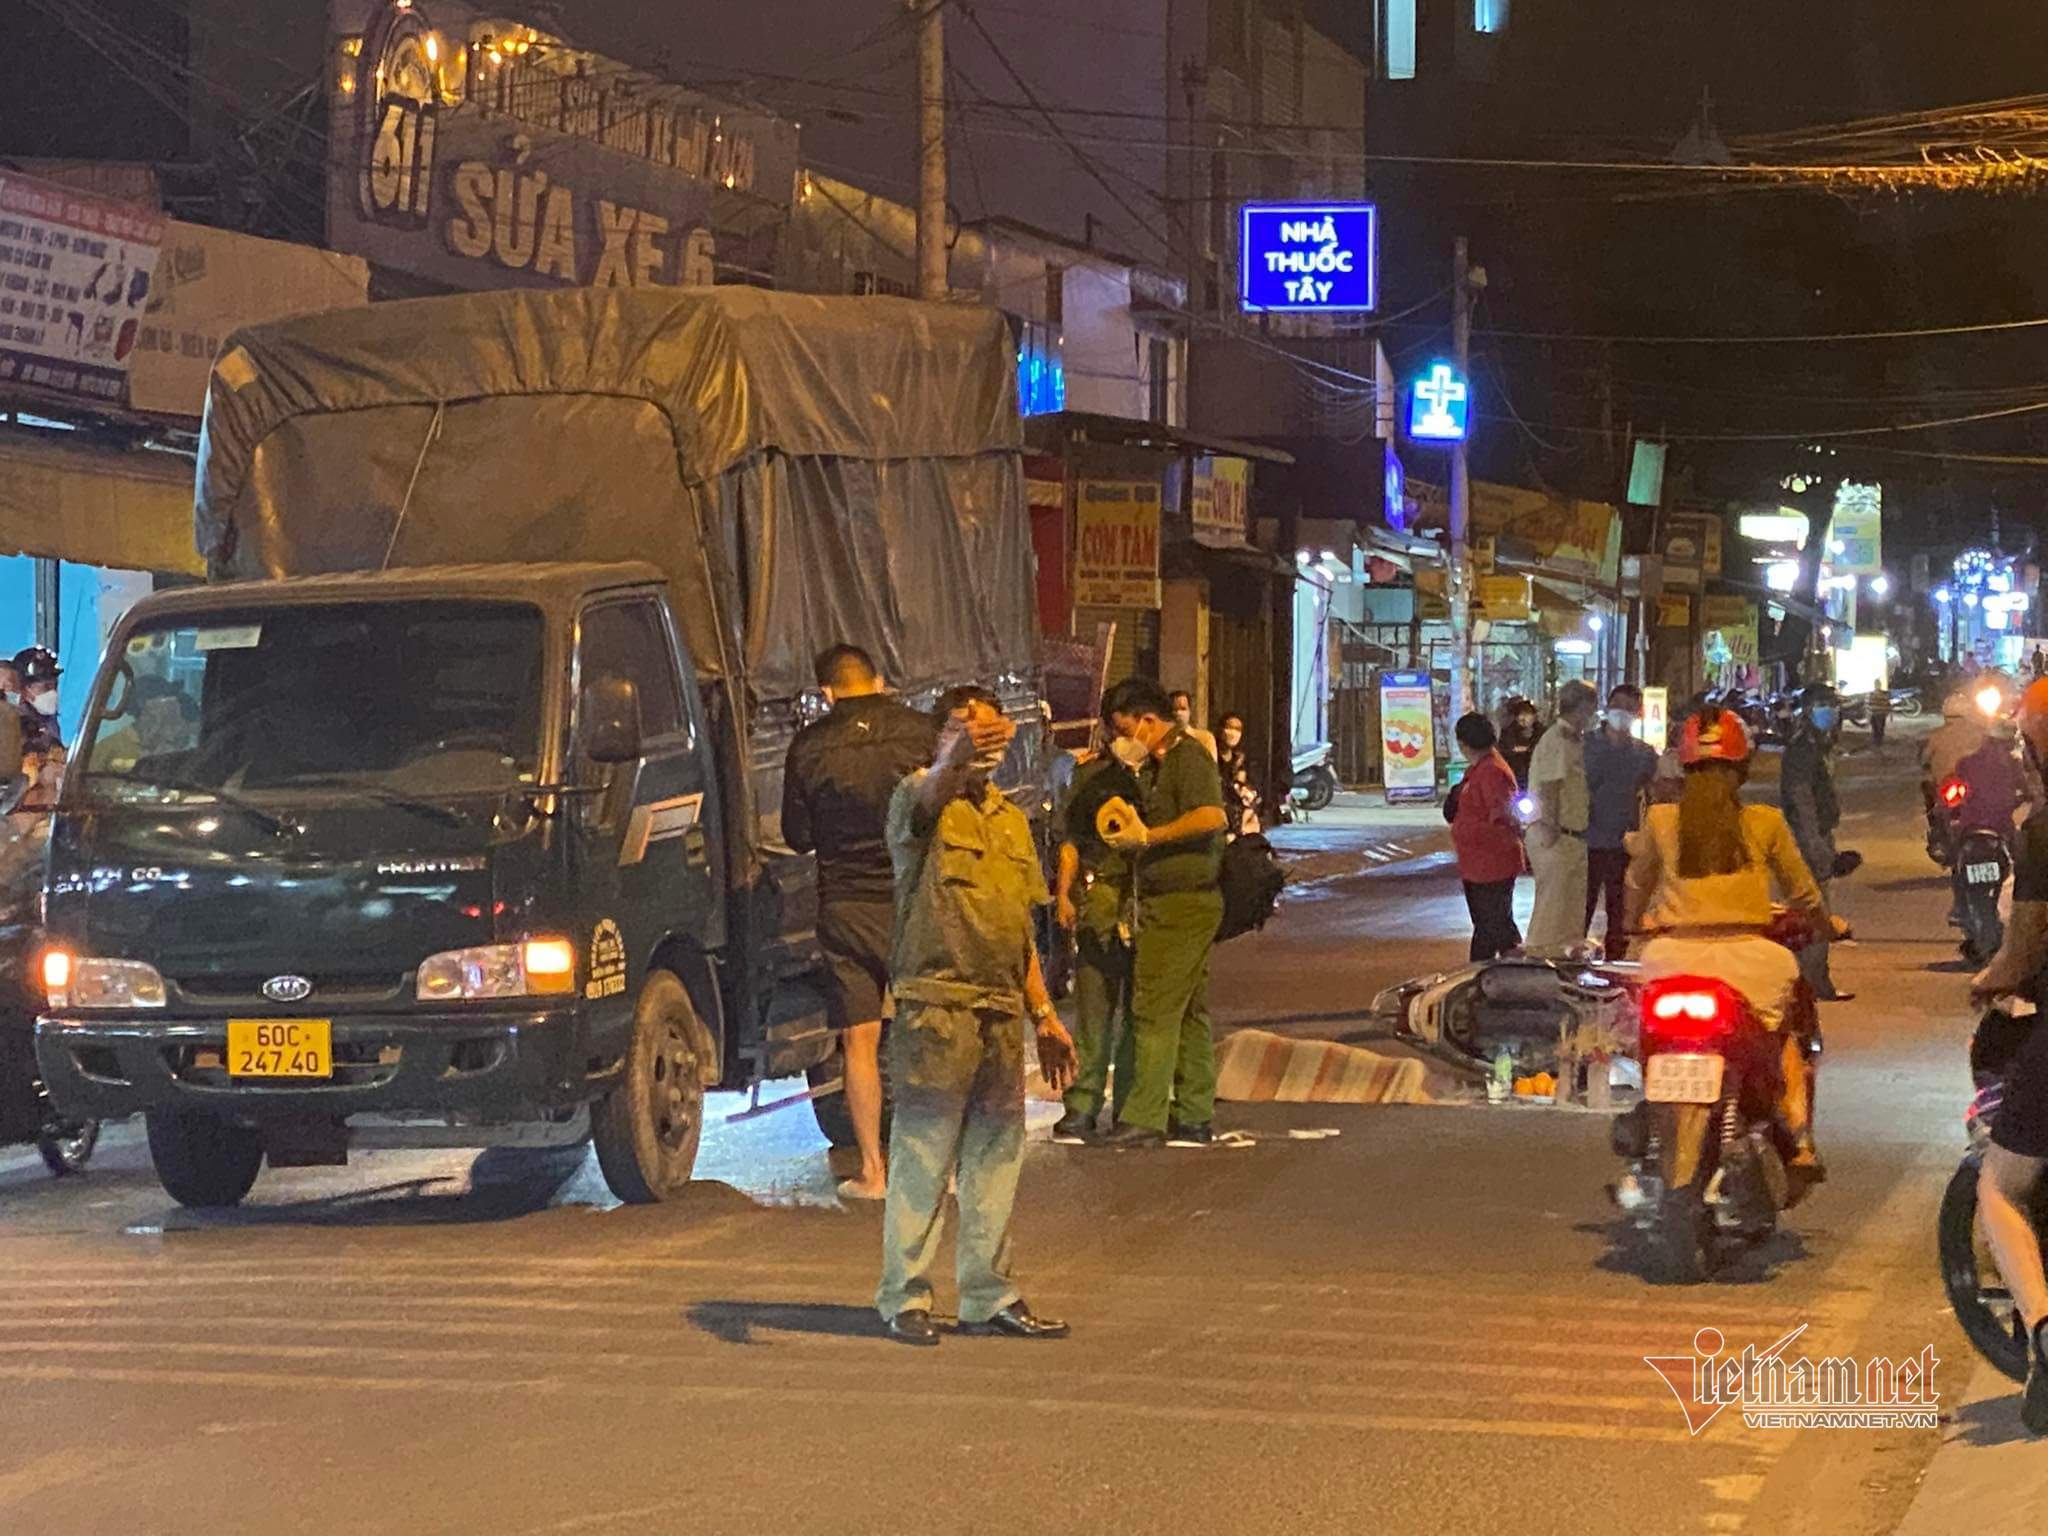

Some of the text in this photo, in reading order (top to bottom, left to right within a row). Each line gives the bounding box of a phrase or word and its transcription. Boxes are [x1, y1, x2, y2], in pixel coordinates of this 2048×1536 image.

[371, 104, 435, 216] 611
[451, 134, 578, 284] SỬA
[594, 200, 669, 288] XE
[1281, 215, 1338, 243] NHÀ
[1264, 241, 1354, 273] THUỐC
[1283, 276, 1334, 303] TÂY
[257, 1025, 300, 1047] 60C
[240, 1050, 319, 1073] 247.40
